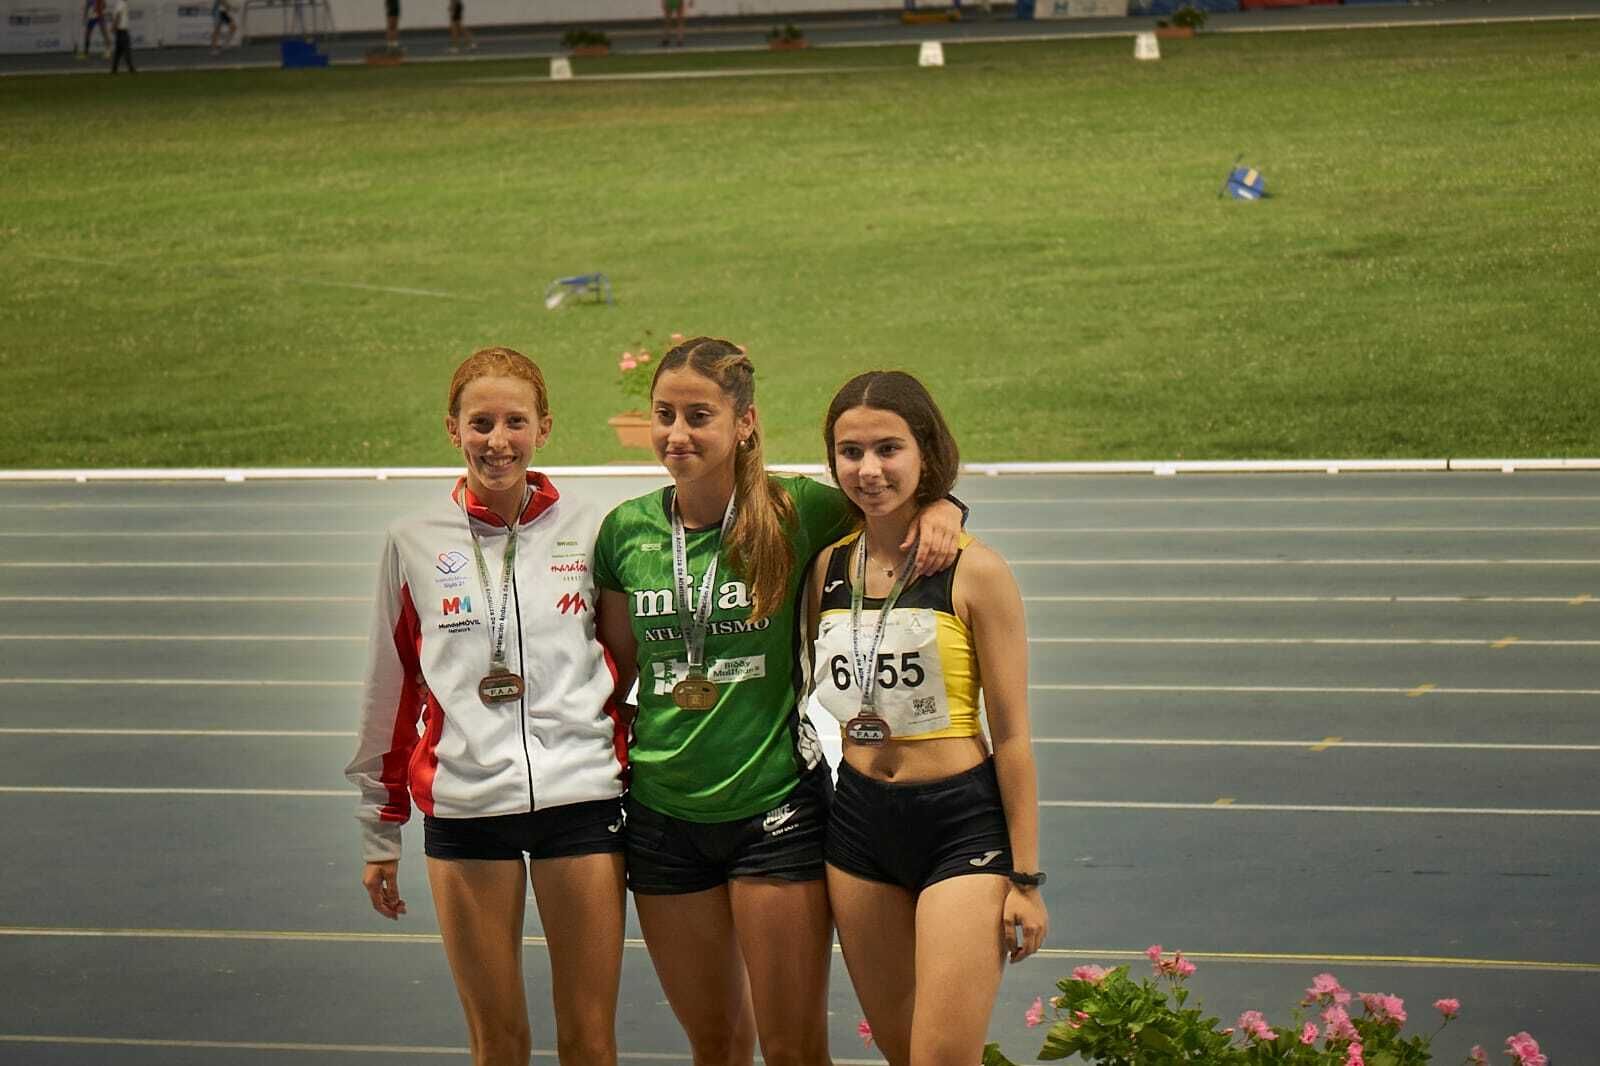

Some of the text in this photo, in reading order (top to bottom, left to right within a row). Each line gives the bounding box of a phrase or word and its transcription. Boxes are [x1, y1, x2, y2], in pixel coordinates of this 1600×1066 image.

[645, 616, 769, 641] ATLISMO
[830, 651, 925, 691] 655
[766, 803, 791, 823] NIKE
